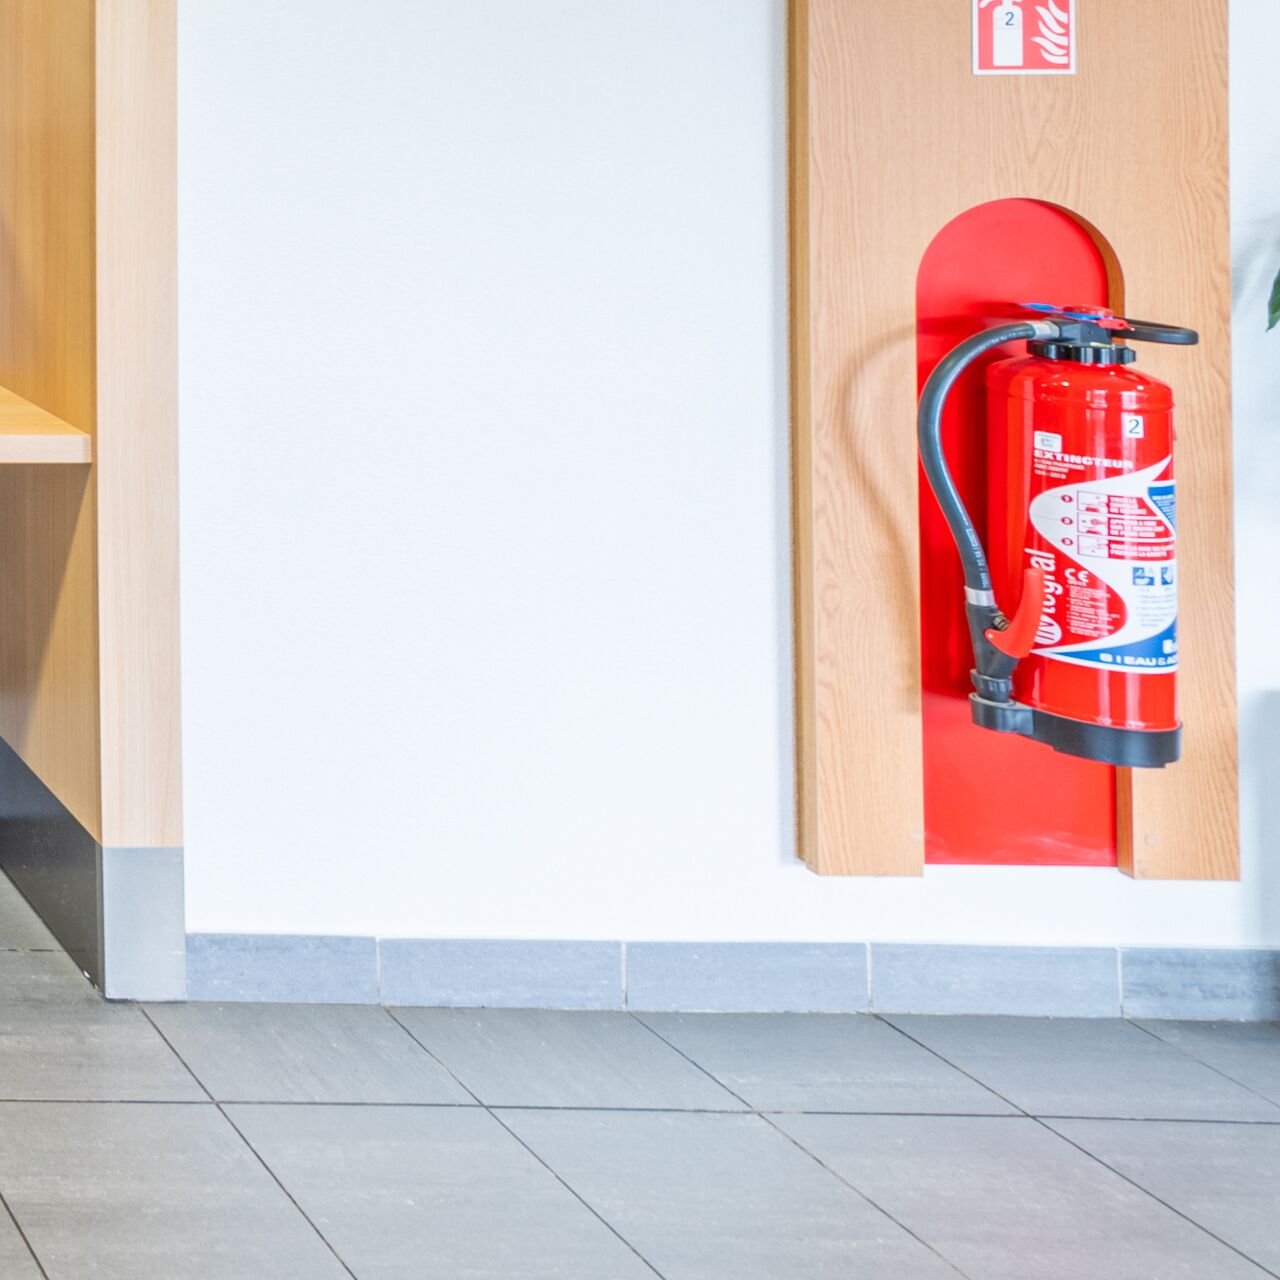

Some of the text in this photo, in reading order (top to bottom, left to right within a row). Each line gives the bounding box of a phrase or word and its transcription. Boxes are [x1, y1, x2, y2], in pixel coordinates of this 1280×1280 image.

[1004, 11, 1016, 27] 2
[1128, 418, 1140, 434] 2
[1033, 448, 1134, 470] EXTINCTEUR
